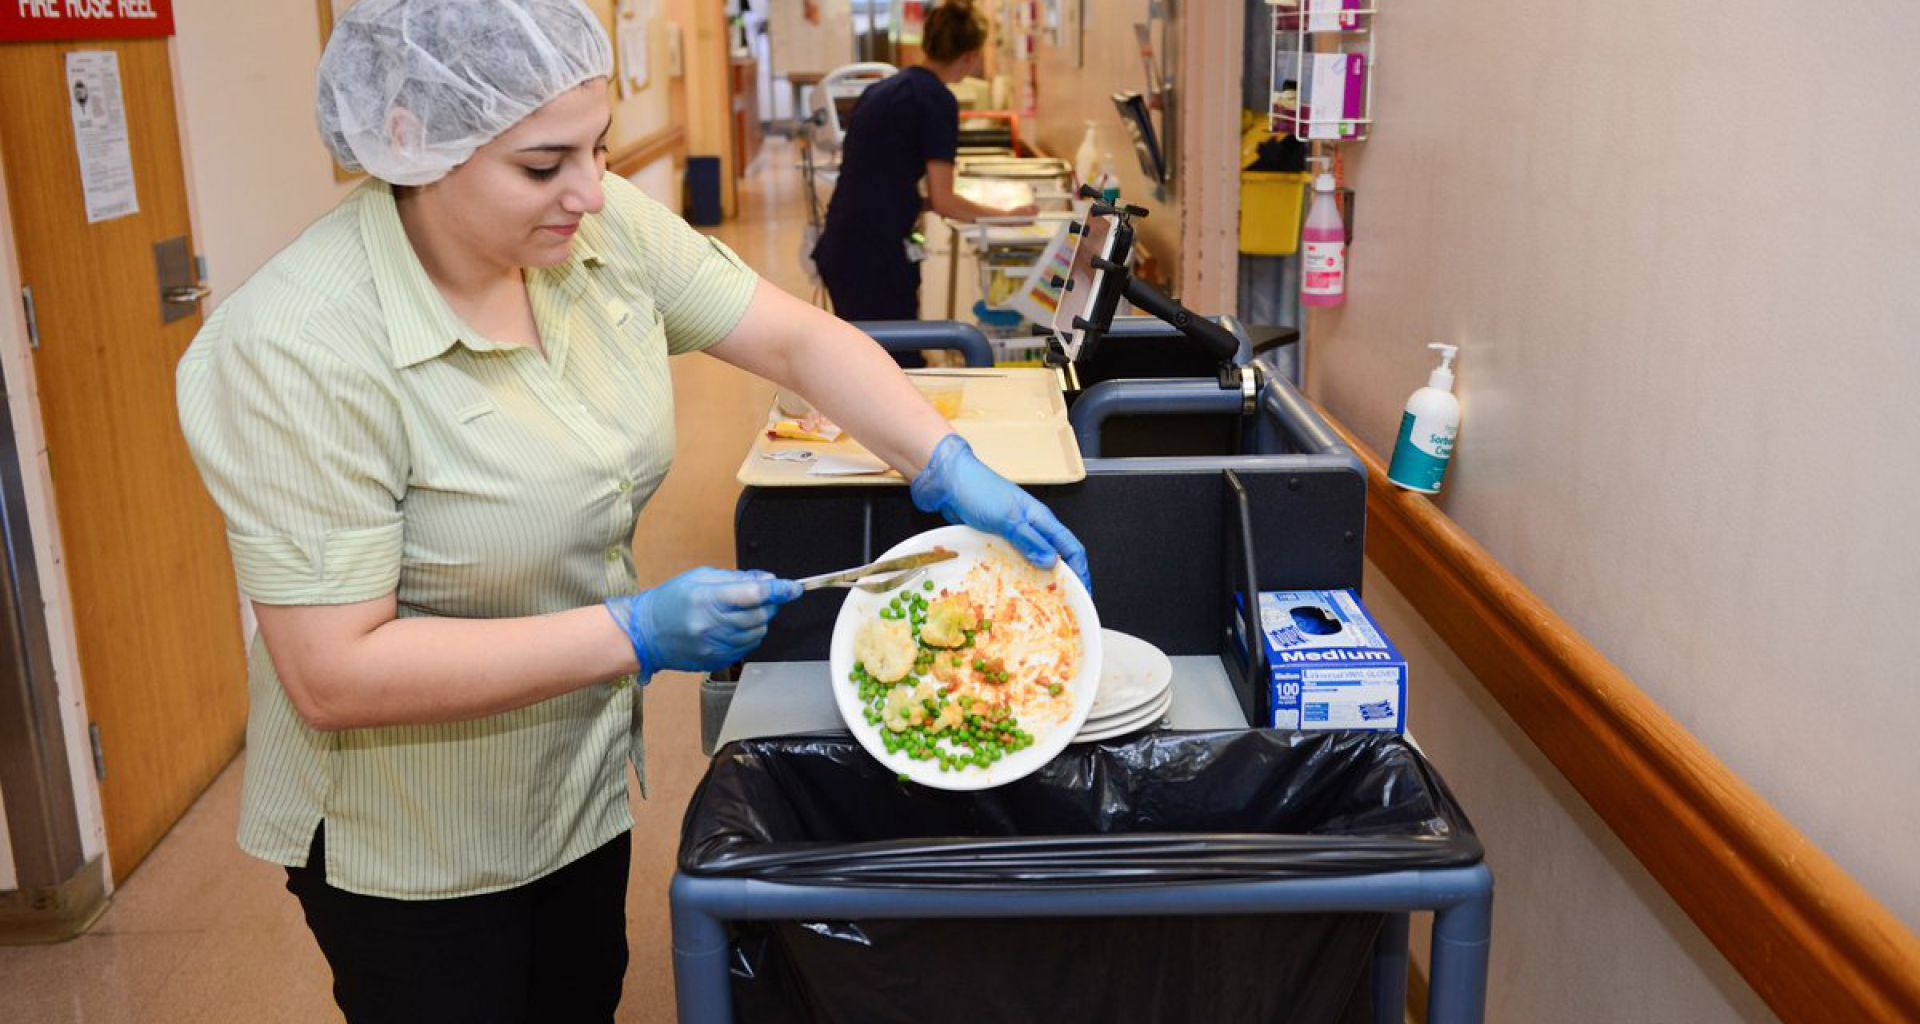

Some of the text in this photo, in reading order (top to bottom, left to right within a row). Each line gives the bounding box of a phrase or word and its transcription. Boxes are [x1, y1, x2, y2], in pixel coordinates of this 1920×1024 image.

[18, 0, 157, 19] FIRE HOSE REEL
[1281, 649, 1391, 663] Medium
[1276, 682, 1300, 695] 100
